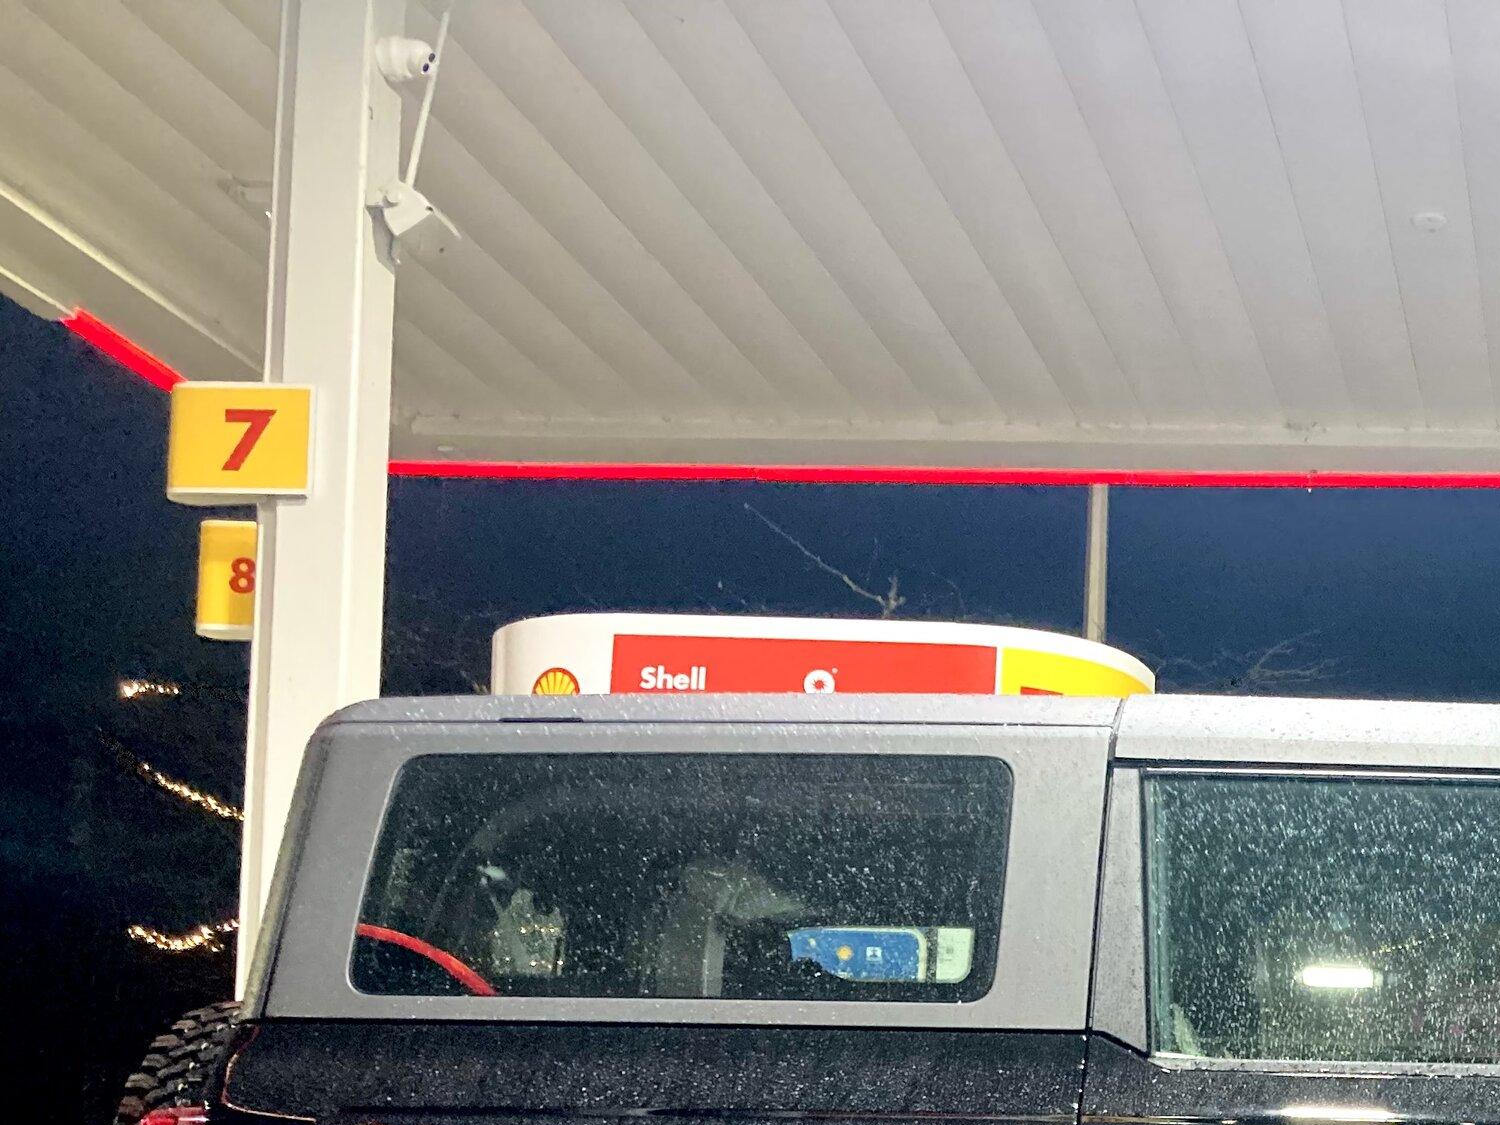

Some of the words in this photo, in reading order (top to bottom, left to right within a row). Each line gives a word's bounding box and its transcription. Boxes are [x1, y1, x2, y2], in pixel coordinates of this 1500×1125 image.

[221, 409, 277, 471] 7
[229, 557, 255, 594] 8
[640, 665, 707, 691] Shell
